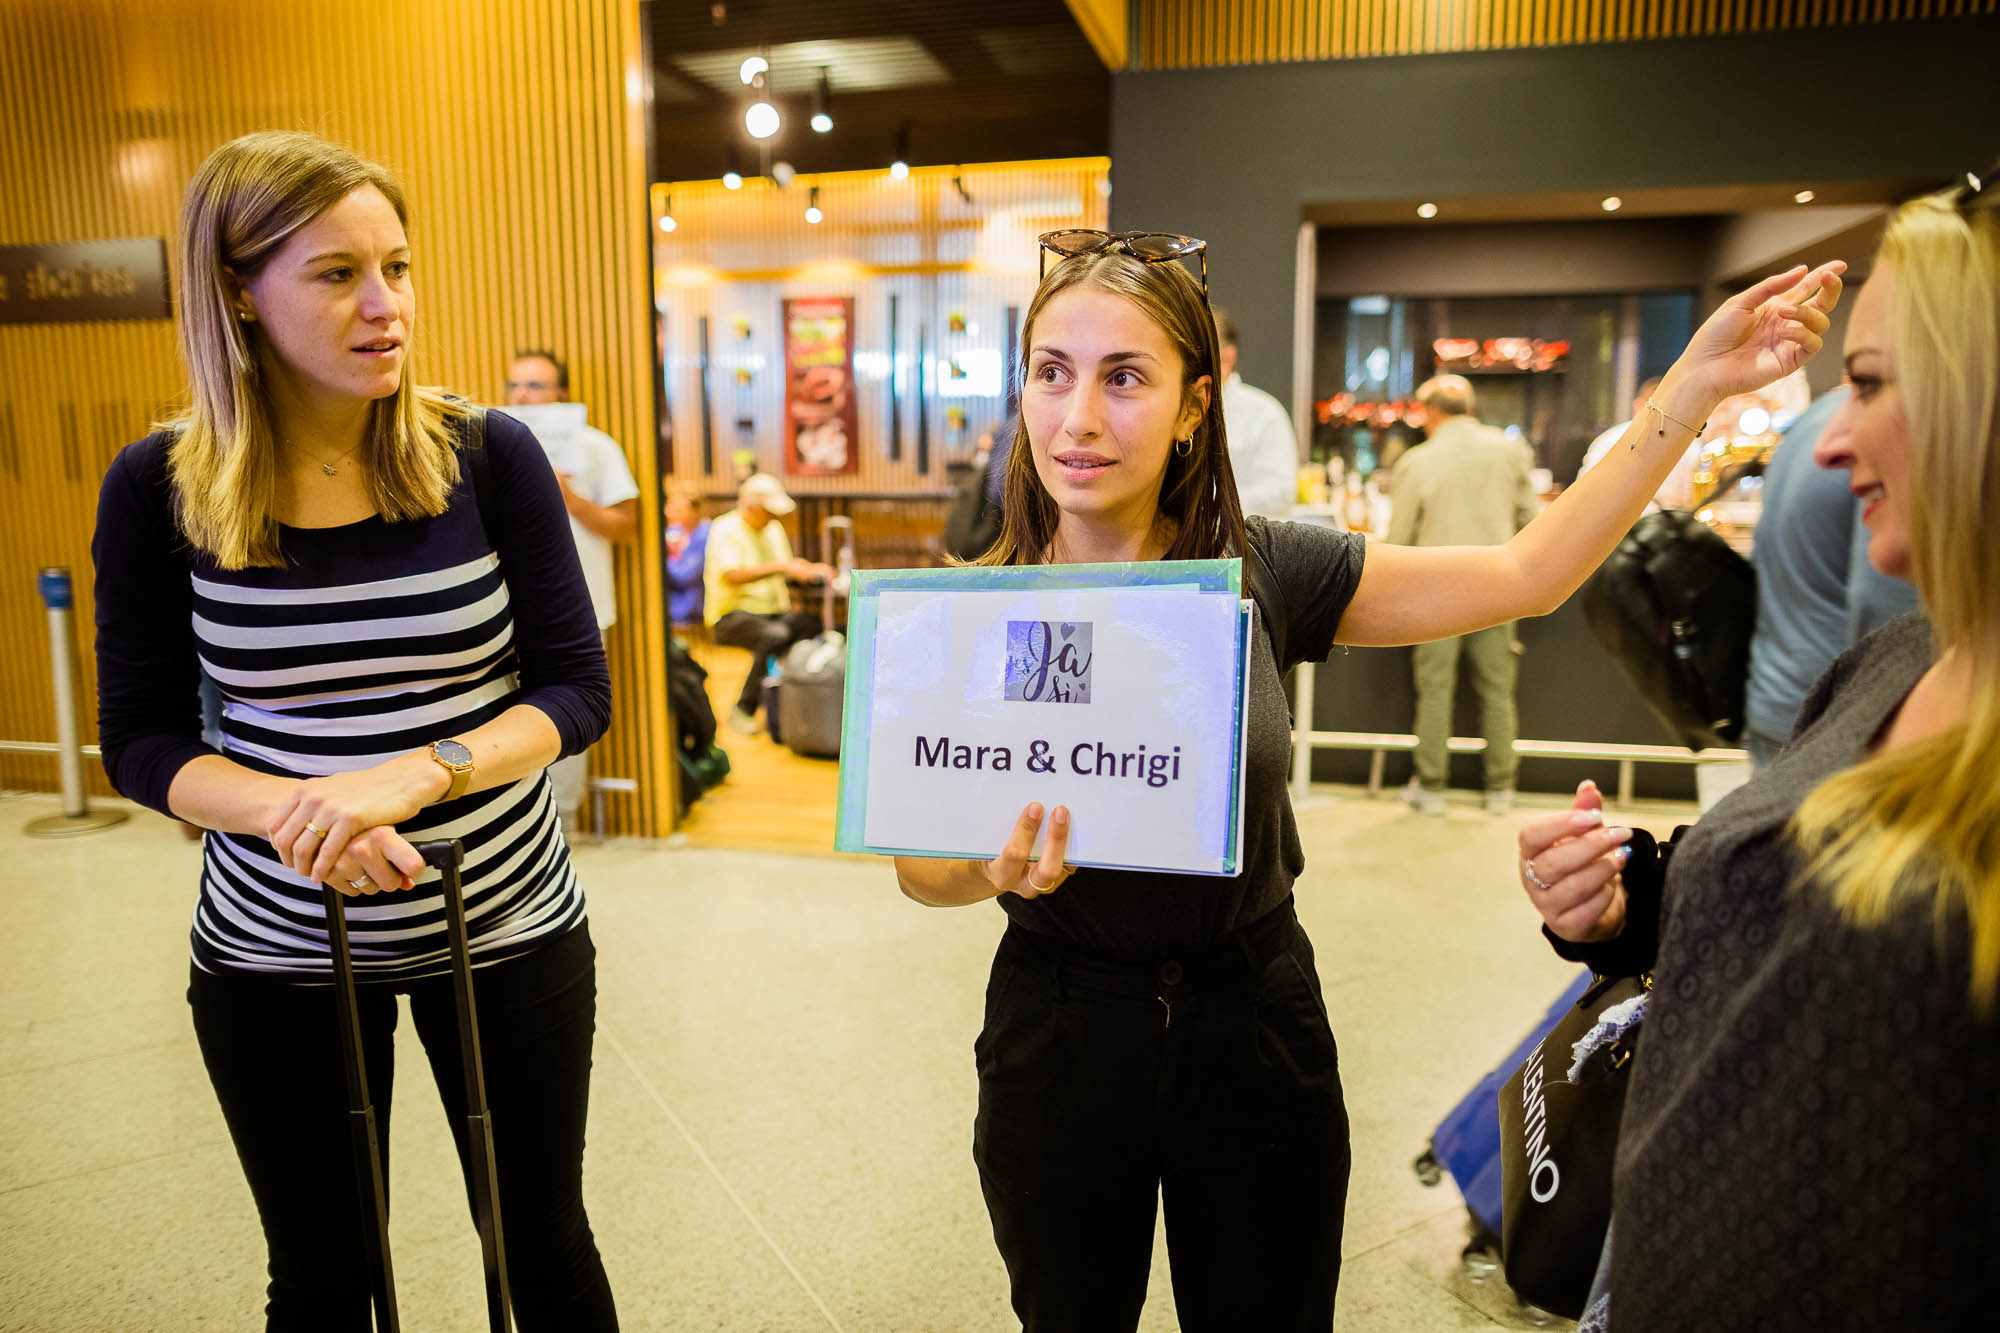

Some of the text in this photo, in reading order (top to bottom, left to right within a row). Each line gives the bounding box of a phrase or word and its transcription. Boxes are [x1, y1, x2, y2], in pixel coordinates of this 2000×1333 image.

[914, 735, 1182, 789] Mara & Chrigi
